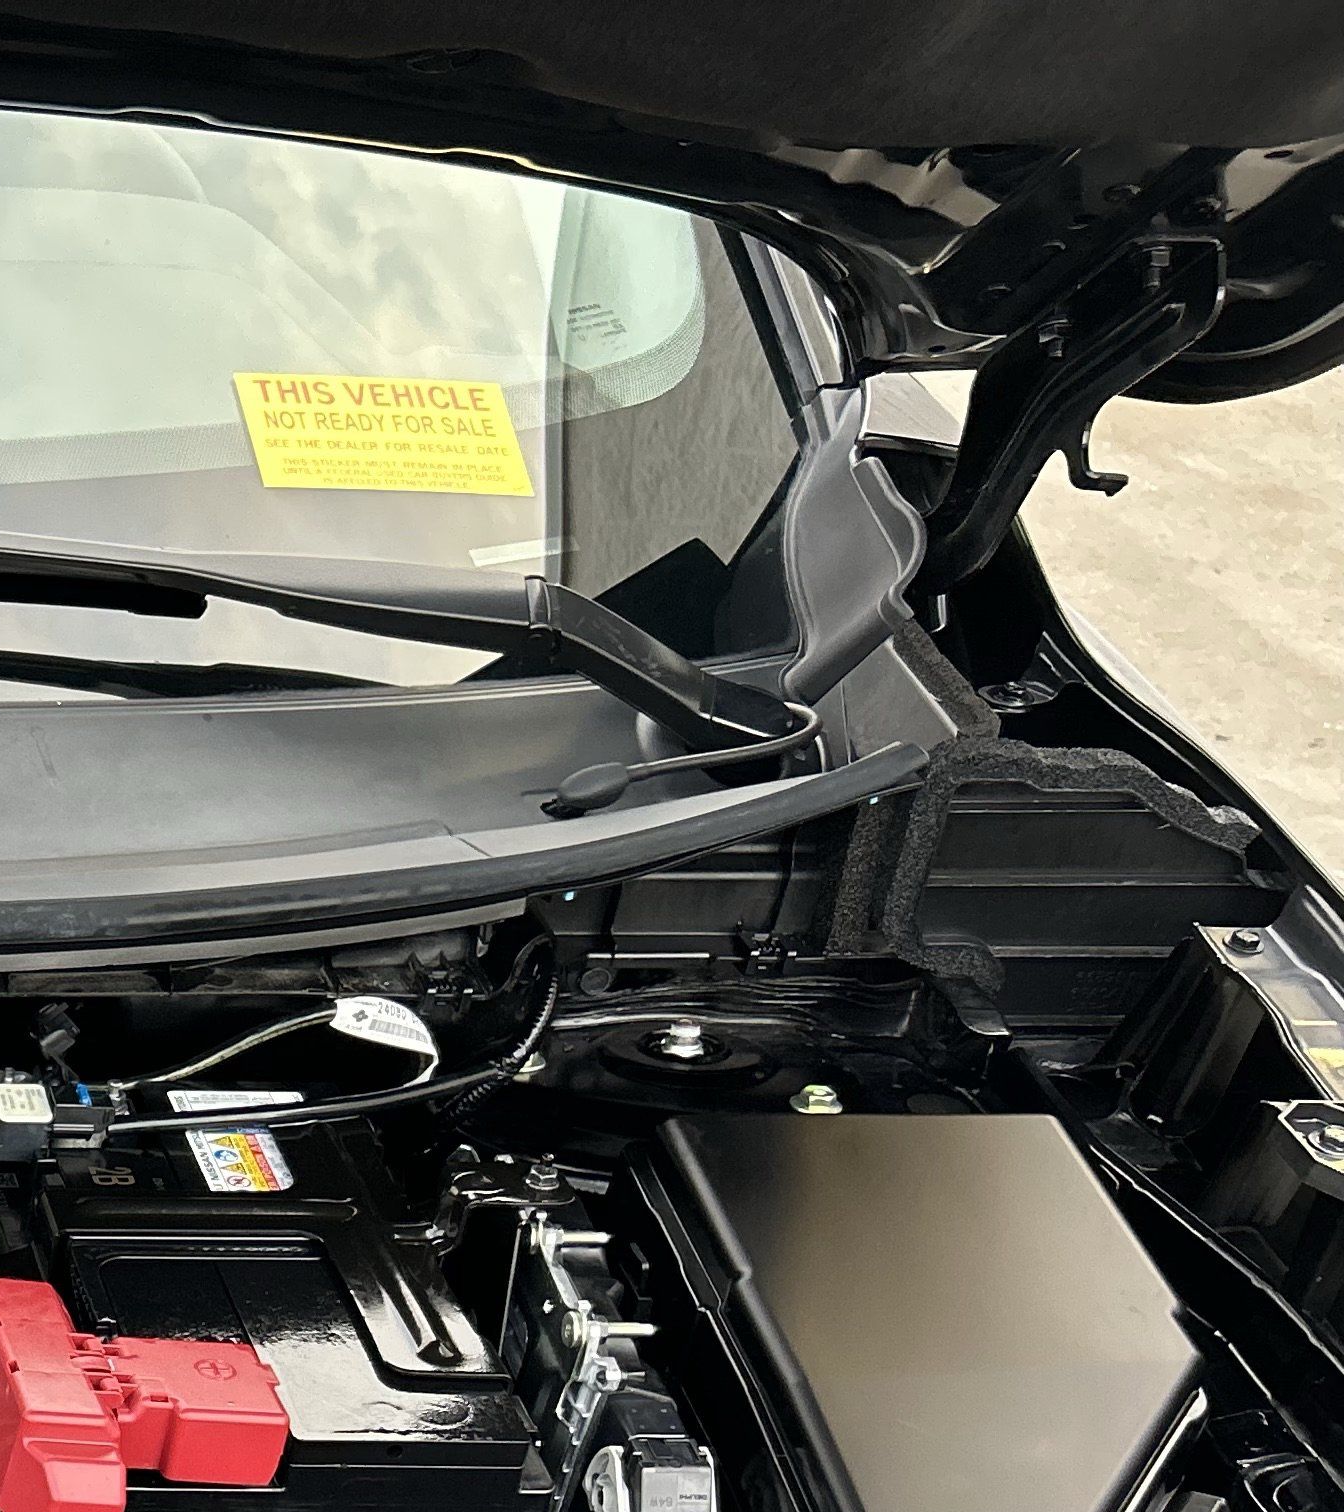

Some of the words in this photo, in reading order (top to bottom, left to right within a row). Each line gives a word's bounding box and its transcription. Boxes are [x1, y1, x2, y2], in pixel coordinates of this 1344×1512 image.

[252, 379, 335, 406] THIS
[342, 382, 490, 411] VEHICLE
[263, 410, 308, 430] NOT
[312, 411, 385, 434] READY
[393, 414, 435, 434] FOR
[441, 416, 497, 438] SALE
[264, 439, 289, 449] SEE
[296, 439, 320, 449] THE
[326, 440, 378, 450] DEALER
[385, 442, 411, 451] FOR
[418, 443, 469, 454] RESALE
[477, 446, 510, 456] DATE
